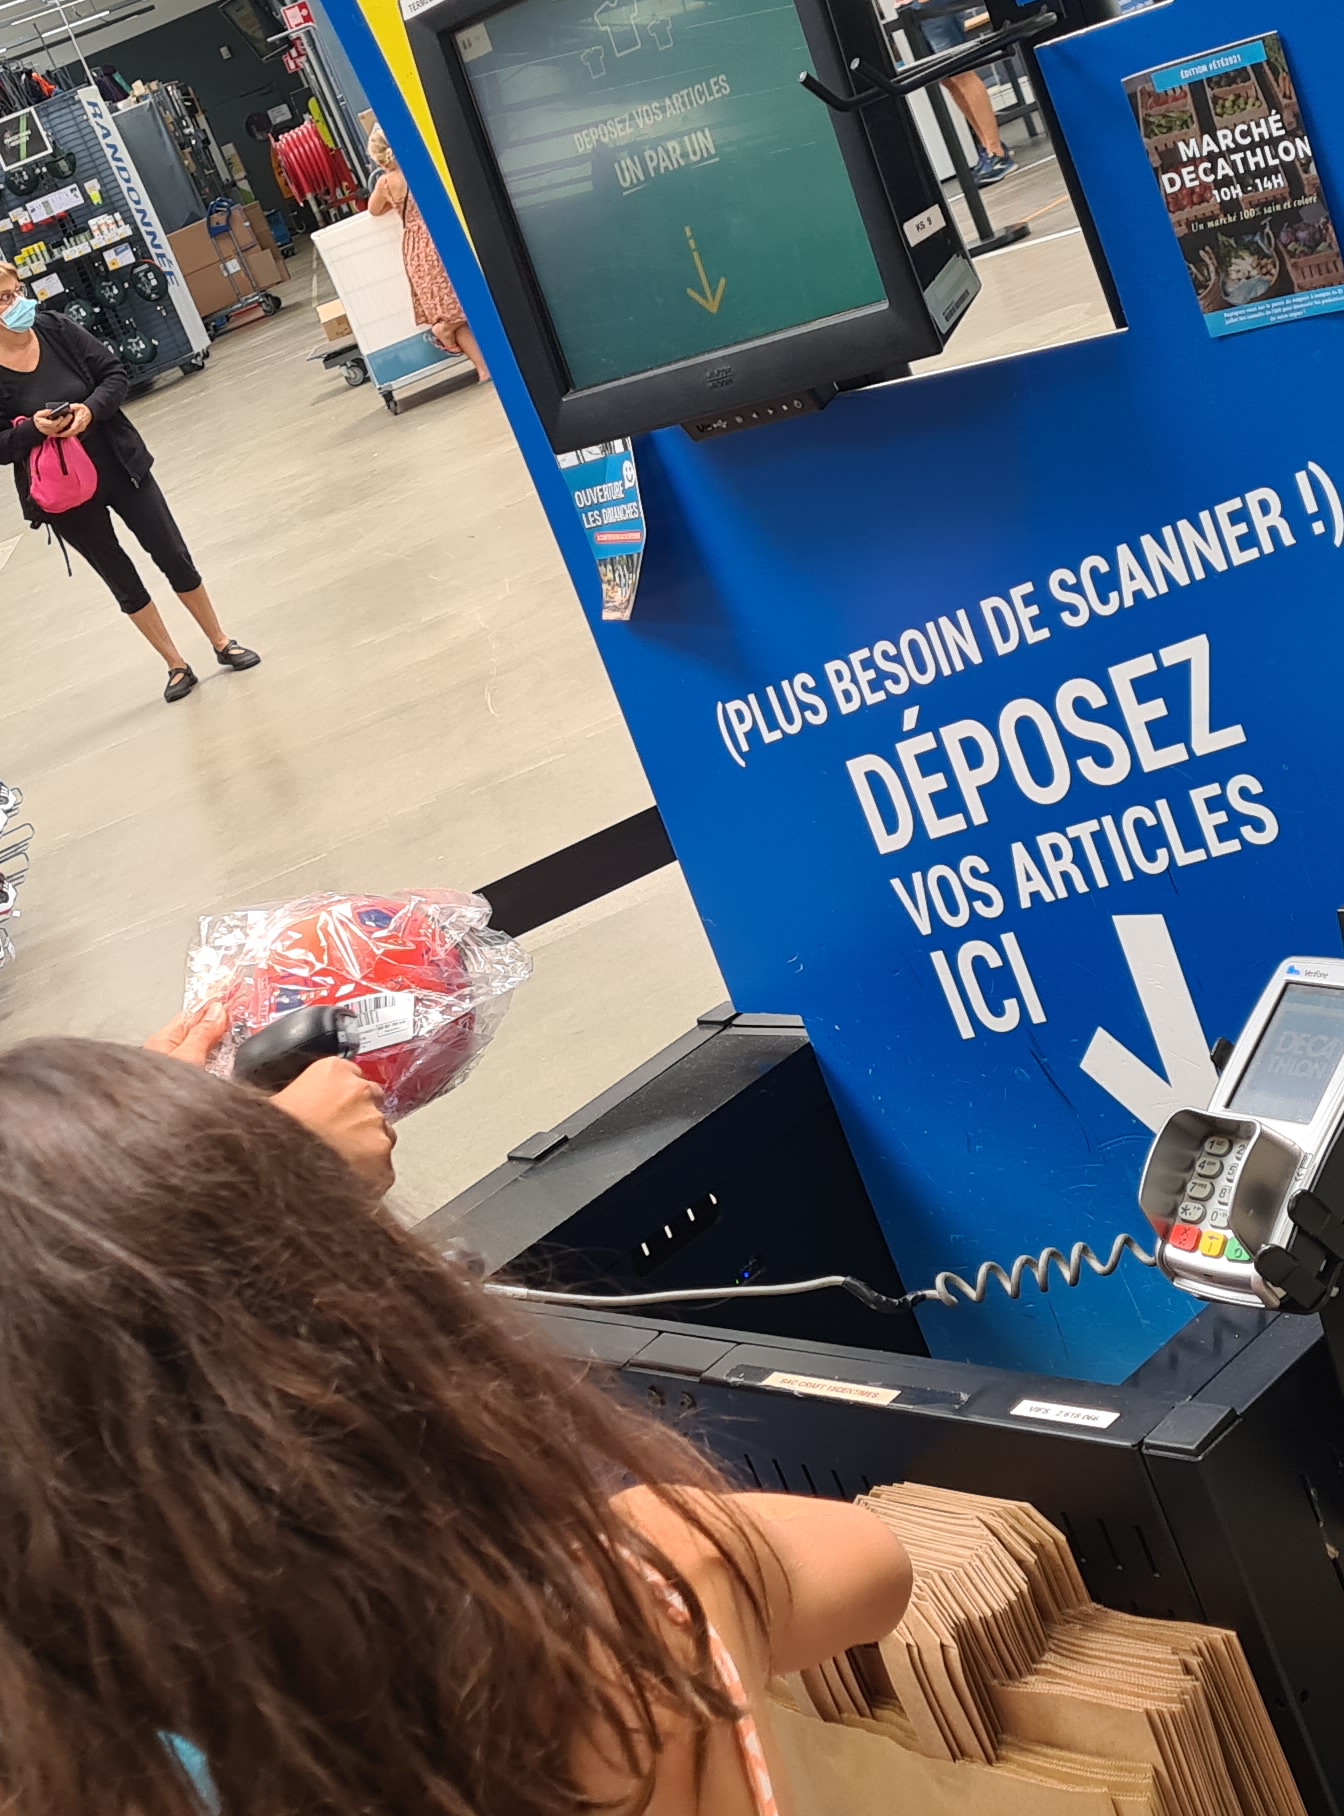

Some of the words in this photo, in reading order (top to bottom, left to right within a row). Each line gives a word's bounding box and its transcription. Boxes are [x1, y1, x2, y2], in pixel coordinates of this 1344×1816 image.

[573, 113, 634, 152] DEPOSEZ
[632, 101, 664, 129] VOS
[664, 73, 731, 118] ARTICLES
[1177, 110, 1286, 162] MARCHÉ
[613, 154, 645, 189] UN
[644, 139, 686, 178] PAR
[683, 127, 717, 162] UN
[1161, 135, 1313, 195] DECATHLON
[86, 100, 180, 288] RANDONNÉE
[1212, 184, 1243, 203] 10H
[1255, 172, 1285, 193] 14H
[915, 221, 926, 233] KS
[1191, 221, 1205, 233] Un
[1207, 212, 1238, 229] marché
[1239, 206, 1262, 221] 100%
[1263, 203, 1282, 215] sain
[1282, 200, 1293, 211] et
[581, 510, 602, 529] LES
[716, 672, 828, 768] (PLUS
[824, 608, 984, 716] BESOIN
[979, 581, 1051, 657] DE
[1048, 486, 1297, 627] SCANNER
[1294, 460, 1344, 548] !)
[845, 633, 1247, 856] DÉPOSEZ
[889, 854, 1004, 936] VOS
[1009, 773, 1279, 909] ARTICLES
[929, 931, 1047, 1040] ICI
[1198, 1160, 1207, 1170] 4
[1209, 1139, 1216, 1150] 1
[1237, 1144, 1246, 1155] 2
[1189, 1181, 1198, 1192] 7
[1218, 1187, 1227, 1198] 8
